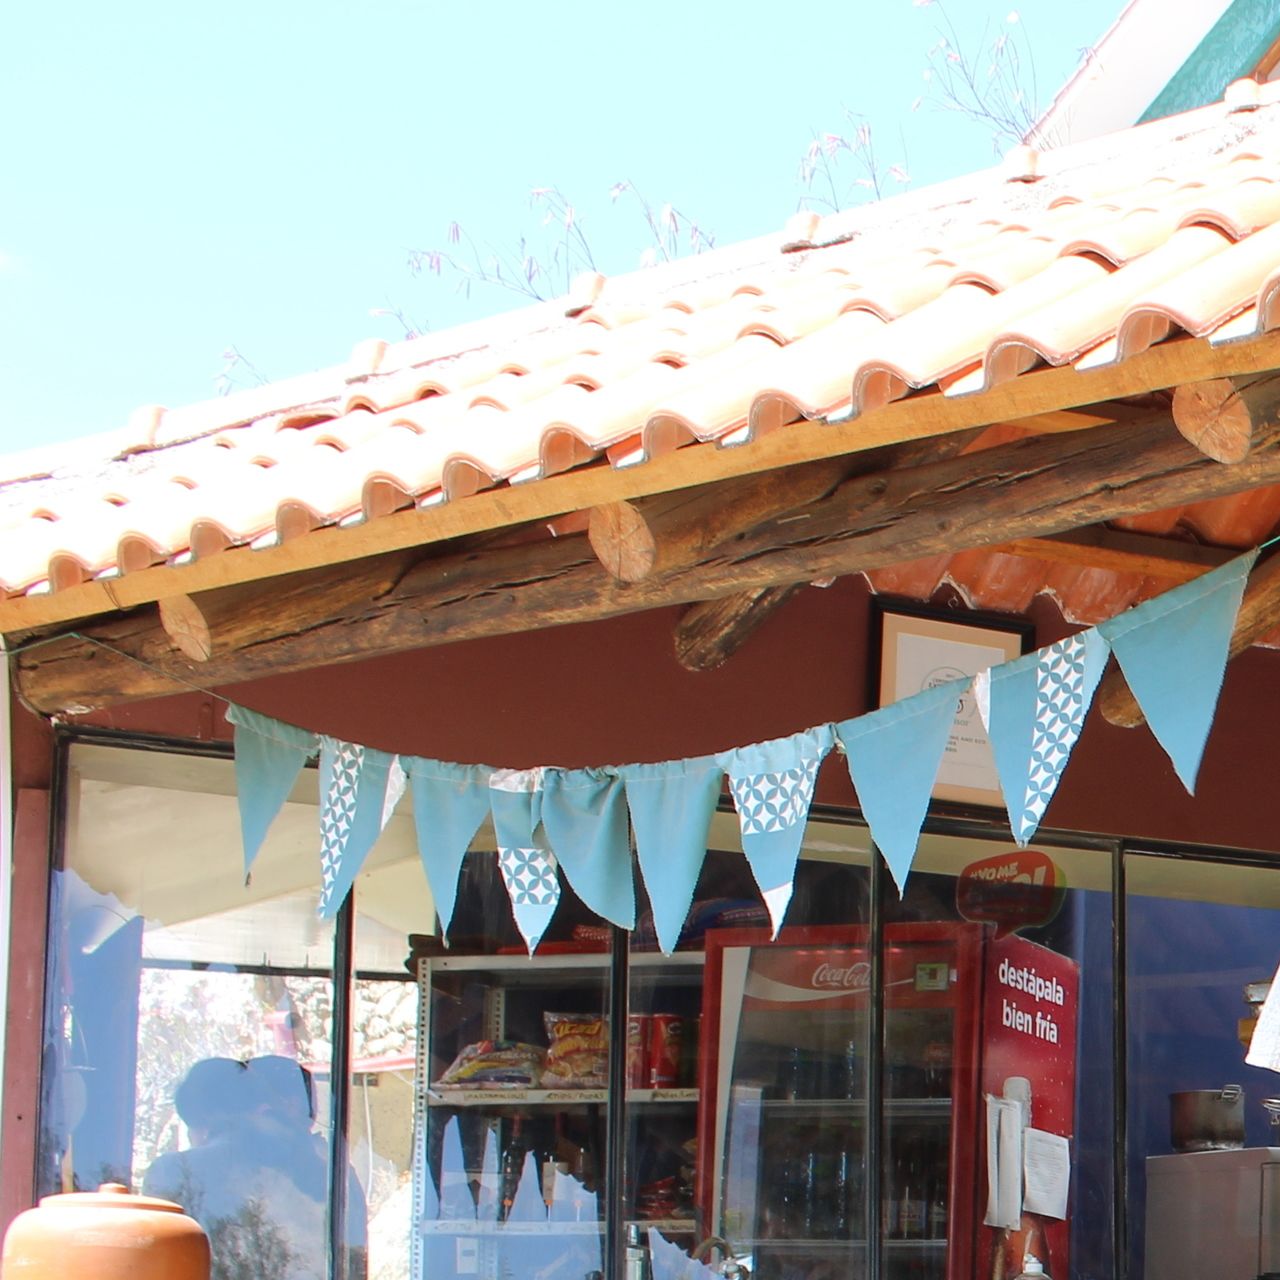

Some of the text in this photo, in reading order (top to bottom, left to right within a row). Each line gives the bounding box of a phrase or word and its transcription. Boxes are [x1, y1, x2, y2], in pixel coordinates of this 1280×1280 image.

[999, 958, 1063, 1005] destápala
[1003, 999, 1057, 1043] bien fría
